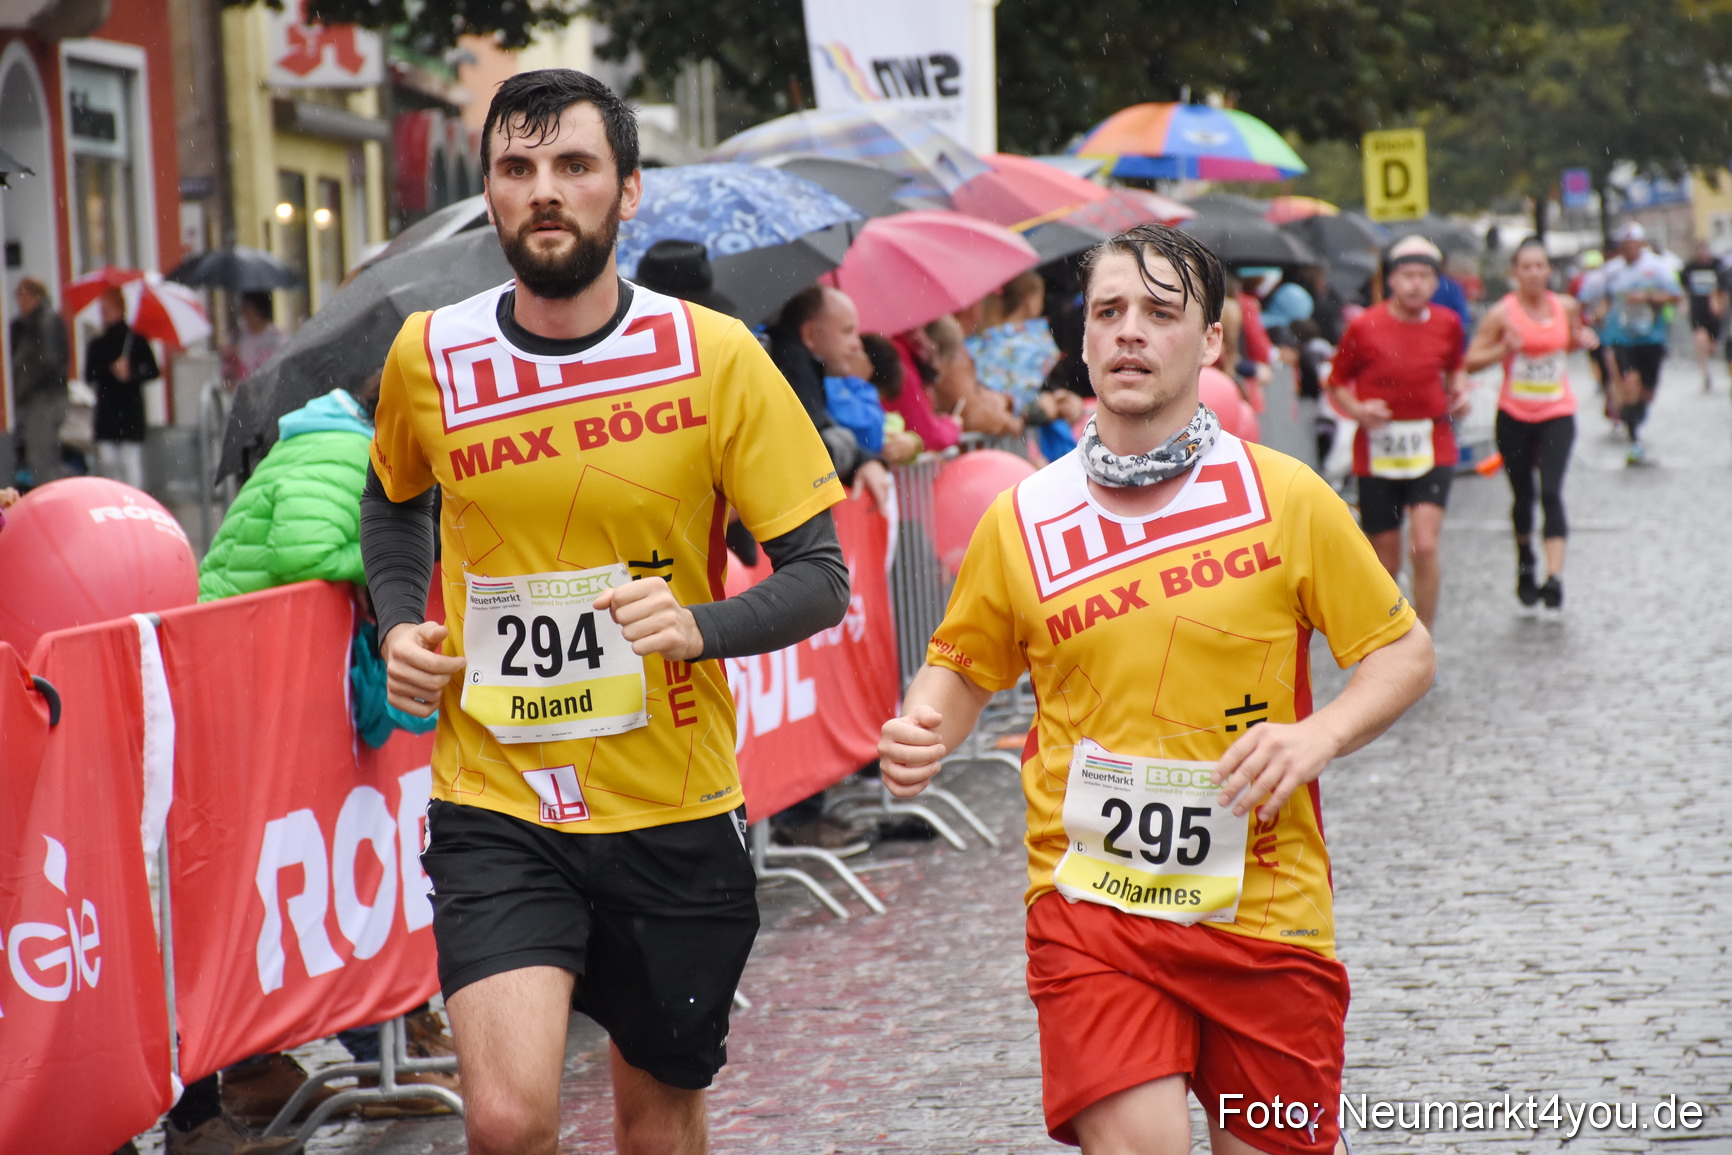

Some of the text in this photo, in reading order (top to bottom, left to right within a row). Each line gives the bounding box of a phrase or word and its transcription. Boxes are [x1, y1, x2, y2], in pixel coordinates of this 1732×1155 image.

[1383, 160, 1410, 199] D
[449, 426, 561, 481] MAX
[574, 397, 707, 451] BÖGL
[469, 594, 521, 605] NeuerMarkt
[527, 572, 613, 598] BOCK
[565, 597, 586, 605] smart
[1045, 541, 1282, 646] MAX BÖGL
[497, 612, 604, 678] 294
[472, 672, 480, 683] C
[510, 689, 593, 719] Roland
[1082, 769, 1134, 787] NeuerMarkt
[1101, 798, 1211, 866] 295
[1092, 871, 1202, 905] Johannes
